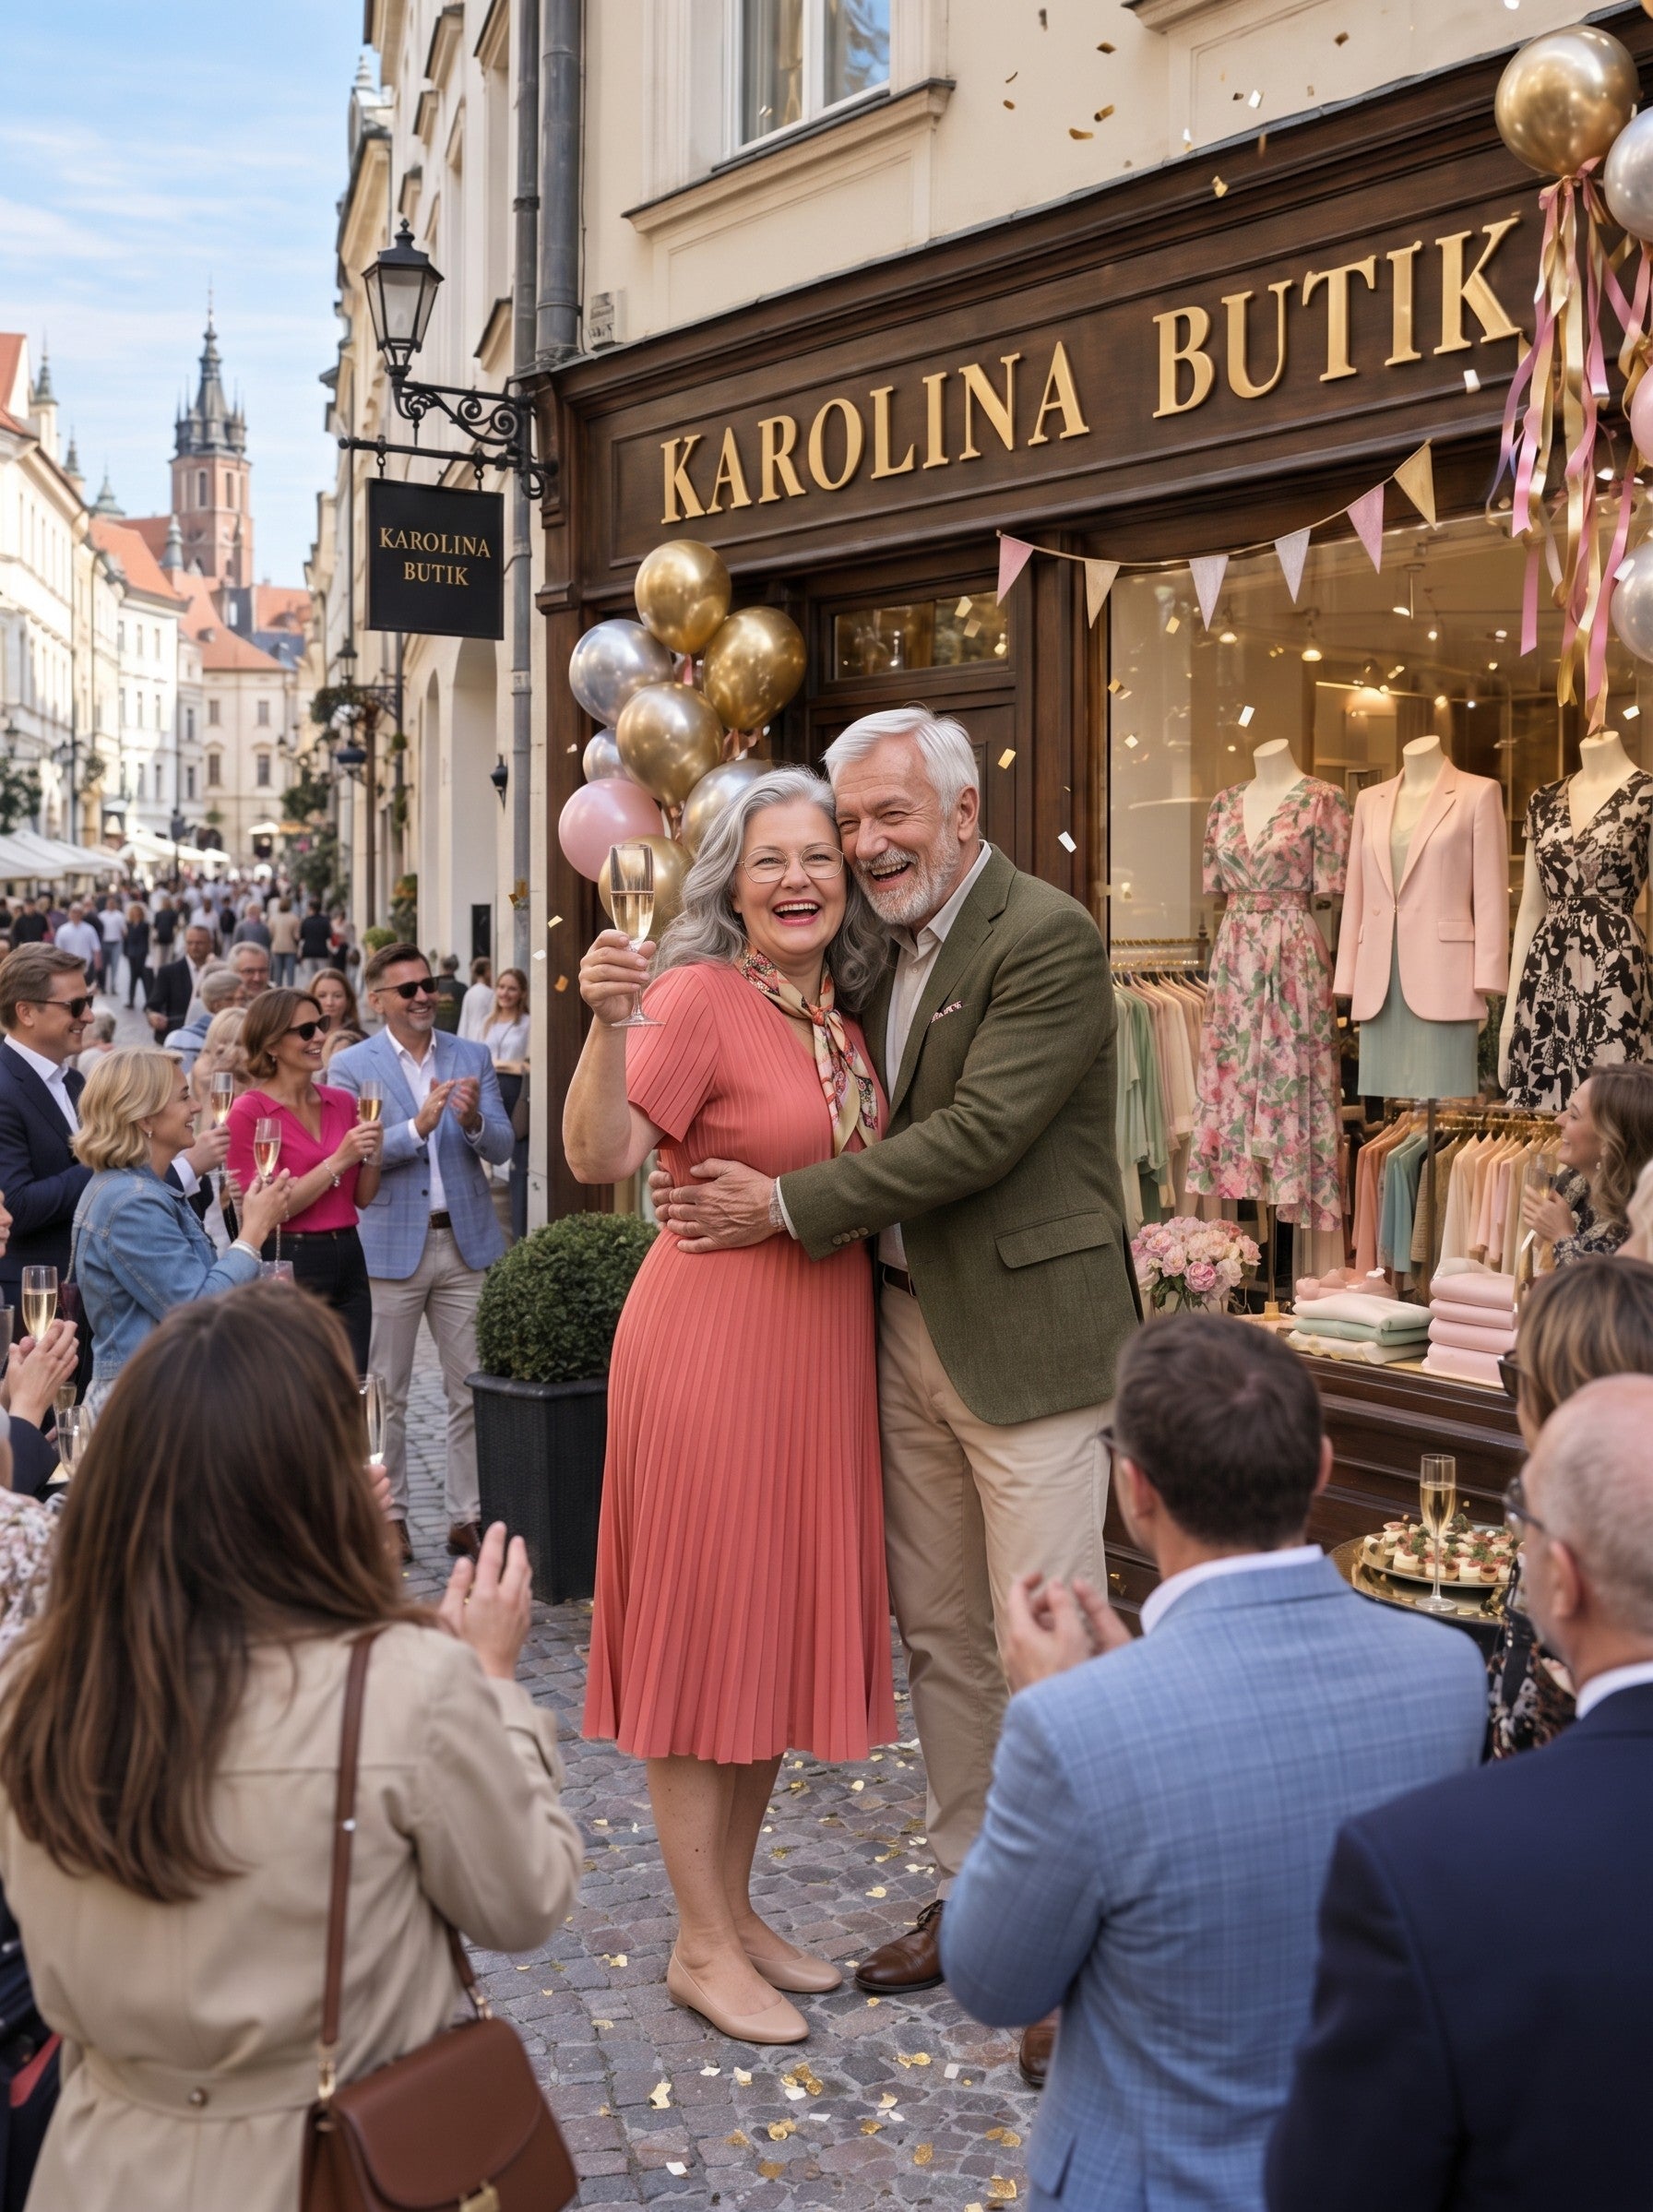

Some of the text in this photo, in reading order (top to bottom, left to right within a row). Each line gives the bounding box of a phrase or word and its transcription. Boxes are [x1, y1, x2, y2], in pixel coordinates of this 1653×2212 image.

[660, 216, 1522, 526] KAROLINA BUTIK
[379, 527, 491, 558] KAROLINA
[404, 562, 469, 586] BUTIK
